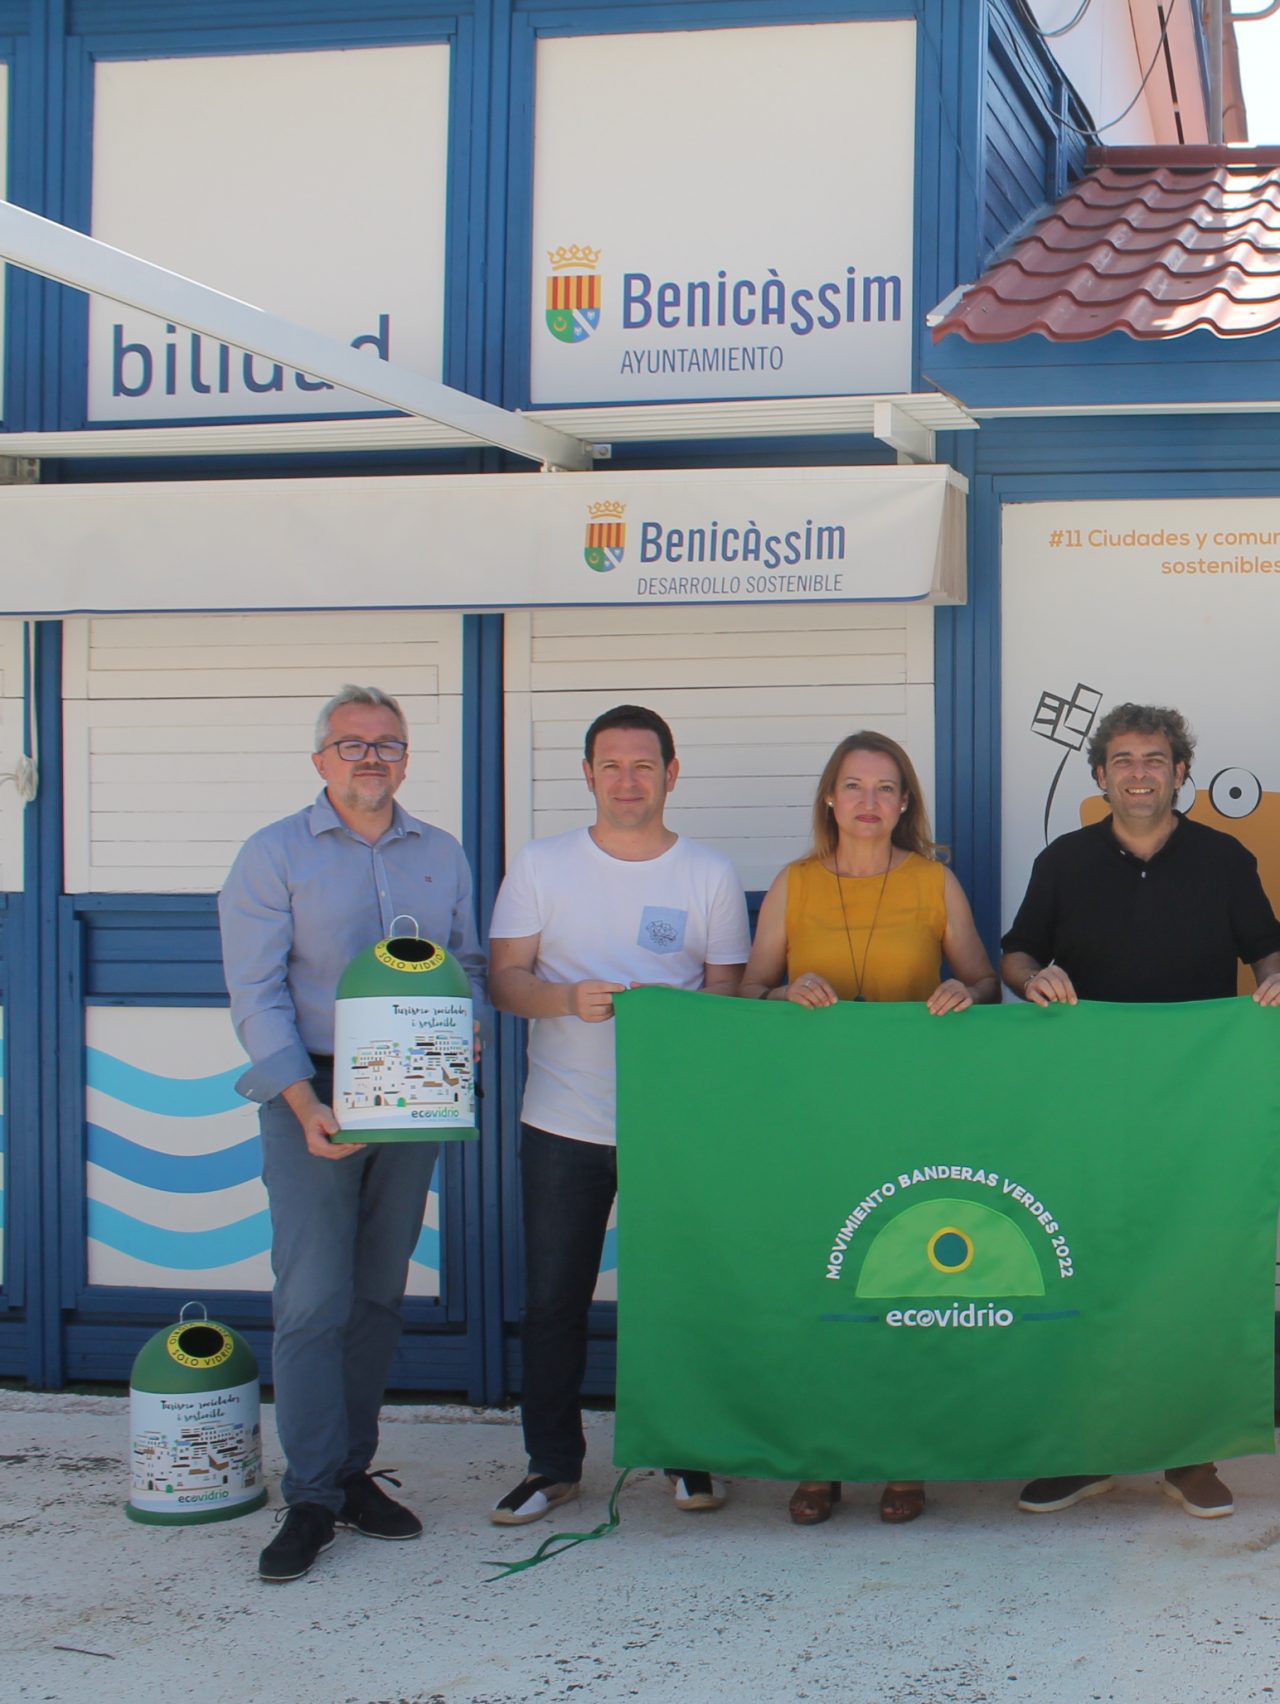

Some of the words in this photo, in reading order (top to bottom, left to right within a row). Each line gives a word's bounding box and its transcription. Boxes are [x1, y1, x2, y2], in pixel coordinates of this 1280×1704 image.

[620, 346, 784, 375] AYUNTAMIENTO
[1049, 530, 1082, 547] #11
[1088, 529, 1190, 547] Ciudades
[1196, 532, 1208, 550] y
[637, 576, 740, 596] DESARROLLO
[746, 574, 843, 593] SOSTENIBLE
[379, 952, 405, 969] SOLO
[411, 953, 443, 970] VIDRIO
[411, 1107, 459, 1119] ecovidrio
[826, 1183, 896, 1280] MOVIMIENTO
[897, 1165, 999, 1189] BANDERAS
[1002, 1178, 1059, 1235] VERDES
[1051, 1236, 1074, 1278] 2022
[886, 1303, 1014, 1328] ecovidrio
[172, 1349, 199, 1366] SOLO
[203, 1343, 232, 1366] VIDRIO
[178, 1490, 229, 1503] ecovidrio
